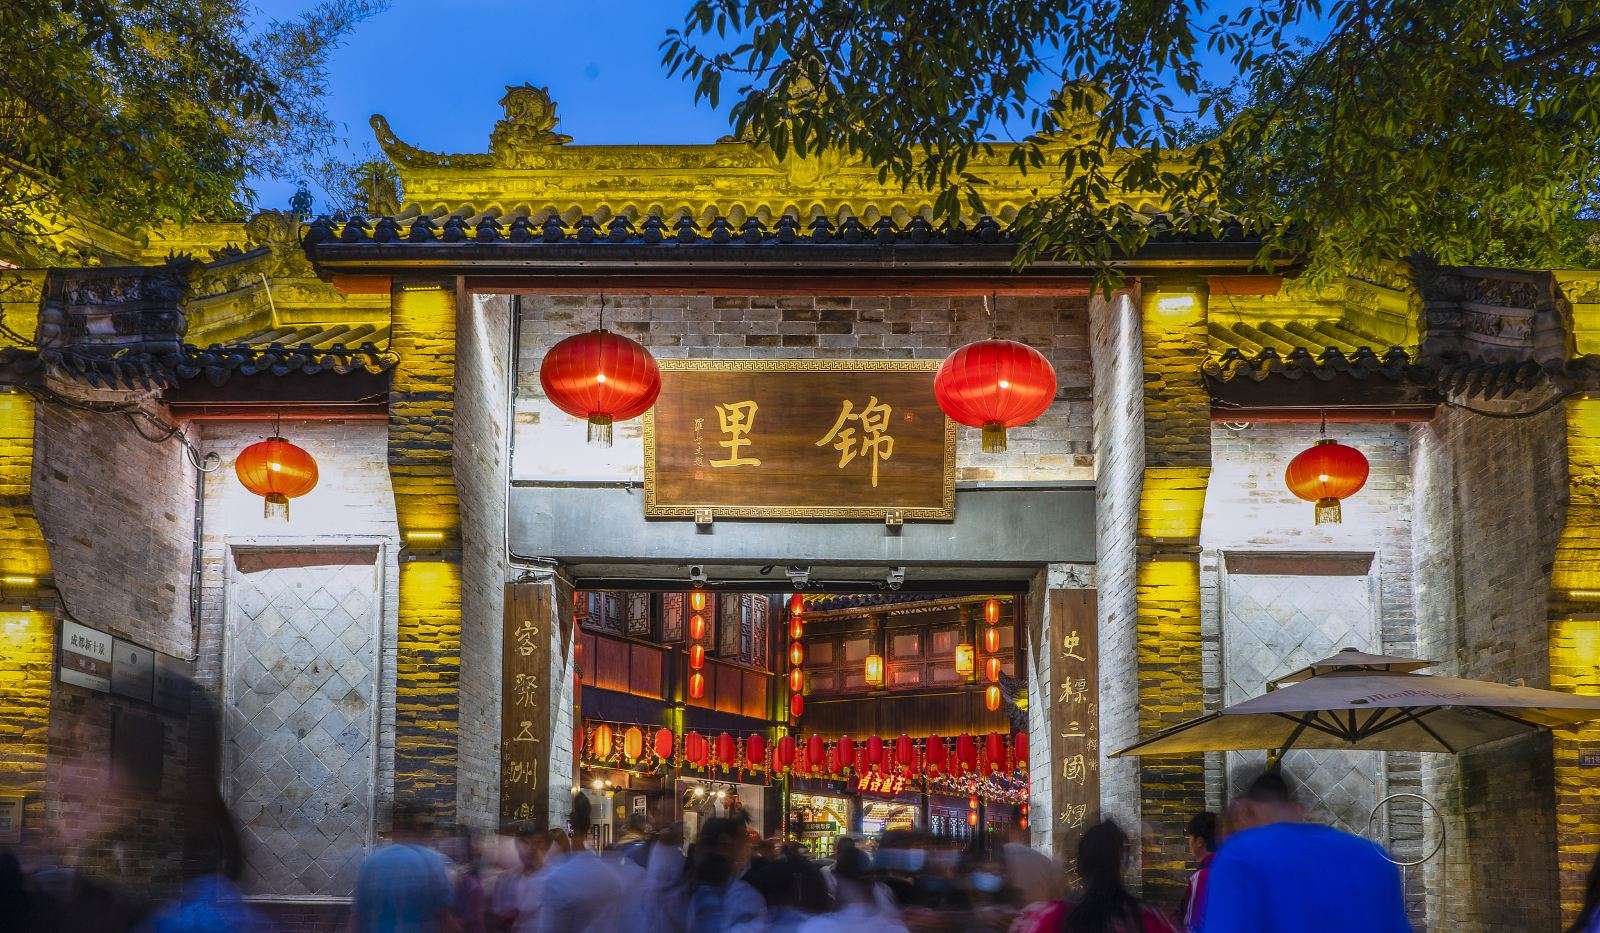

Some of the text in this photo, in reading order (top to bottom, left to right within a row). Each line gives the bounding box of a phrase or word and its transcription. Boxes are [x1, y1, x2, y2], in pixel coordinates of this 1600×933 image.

[70, 632, 106, 656] 成都新十景
